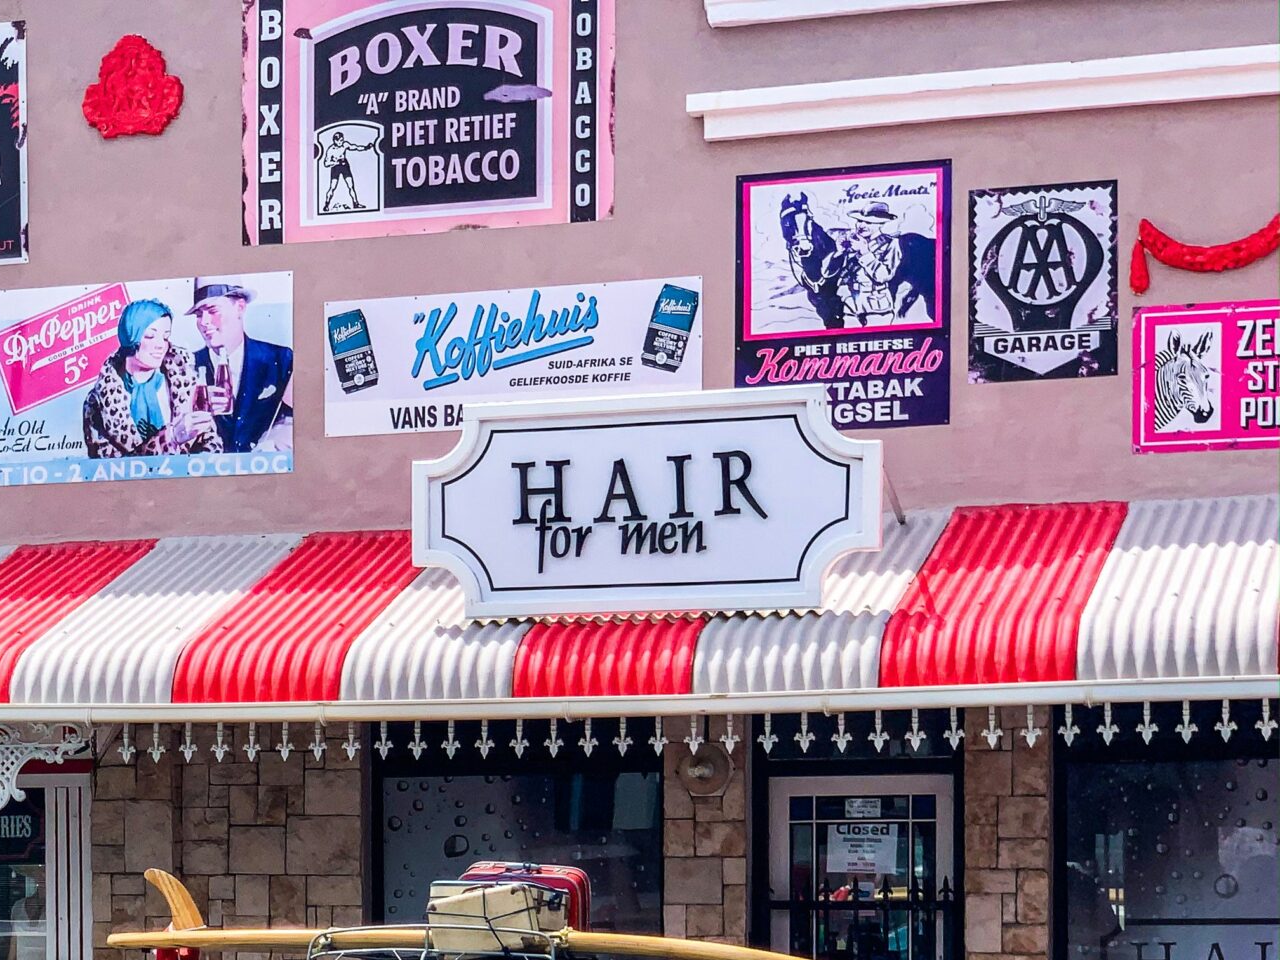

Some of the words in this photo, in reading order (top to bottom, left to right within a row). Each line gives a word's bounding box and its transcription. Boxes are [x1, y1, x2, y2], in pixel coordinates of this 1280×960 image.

[328, 23, 523, 96] BOXER
[395, 86, 461, 113] BRAND
[575, 0, 592, 208] OBACCO
[260, 9, 282, 230] BOXER
[392, 119, 438, 147] PIET
[445, 113, 517, 144] RETIEF
[392, 149, 519, 189] TOBACCO
[68, 295, 102, 316] DRINK
[795, 344, 832, 357] PIET
[836, 338, 913, 353] RETIEFSE
[993, 333, 1092, 355] GARAGE
[745, 337, 943, 385] Kommando
[509, 374, 589, 388] GELIEFKOOSDE
[591, 372, 631, 384] KOFFIE
[389, 405, 438, 430] VANS
[827, 400, 909, 424] GSEL
[19, 420, 45, 436] Old
[34, 435, 83, 451] Custom
[70, 463, 85, 482] 2
[92, 459, 147, 482] AND
[159, 458, 173, 476] 4
[511, 450, 768, 525] HAIR
[535, 499, 593, 574] for
[618, 520, 707, 555] men
[836, 824, 890, 836] Closed
